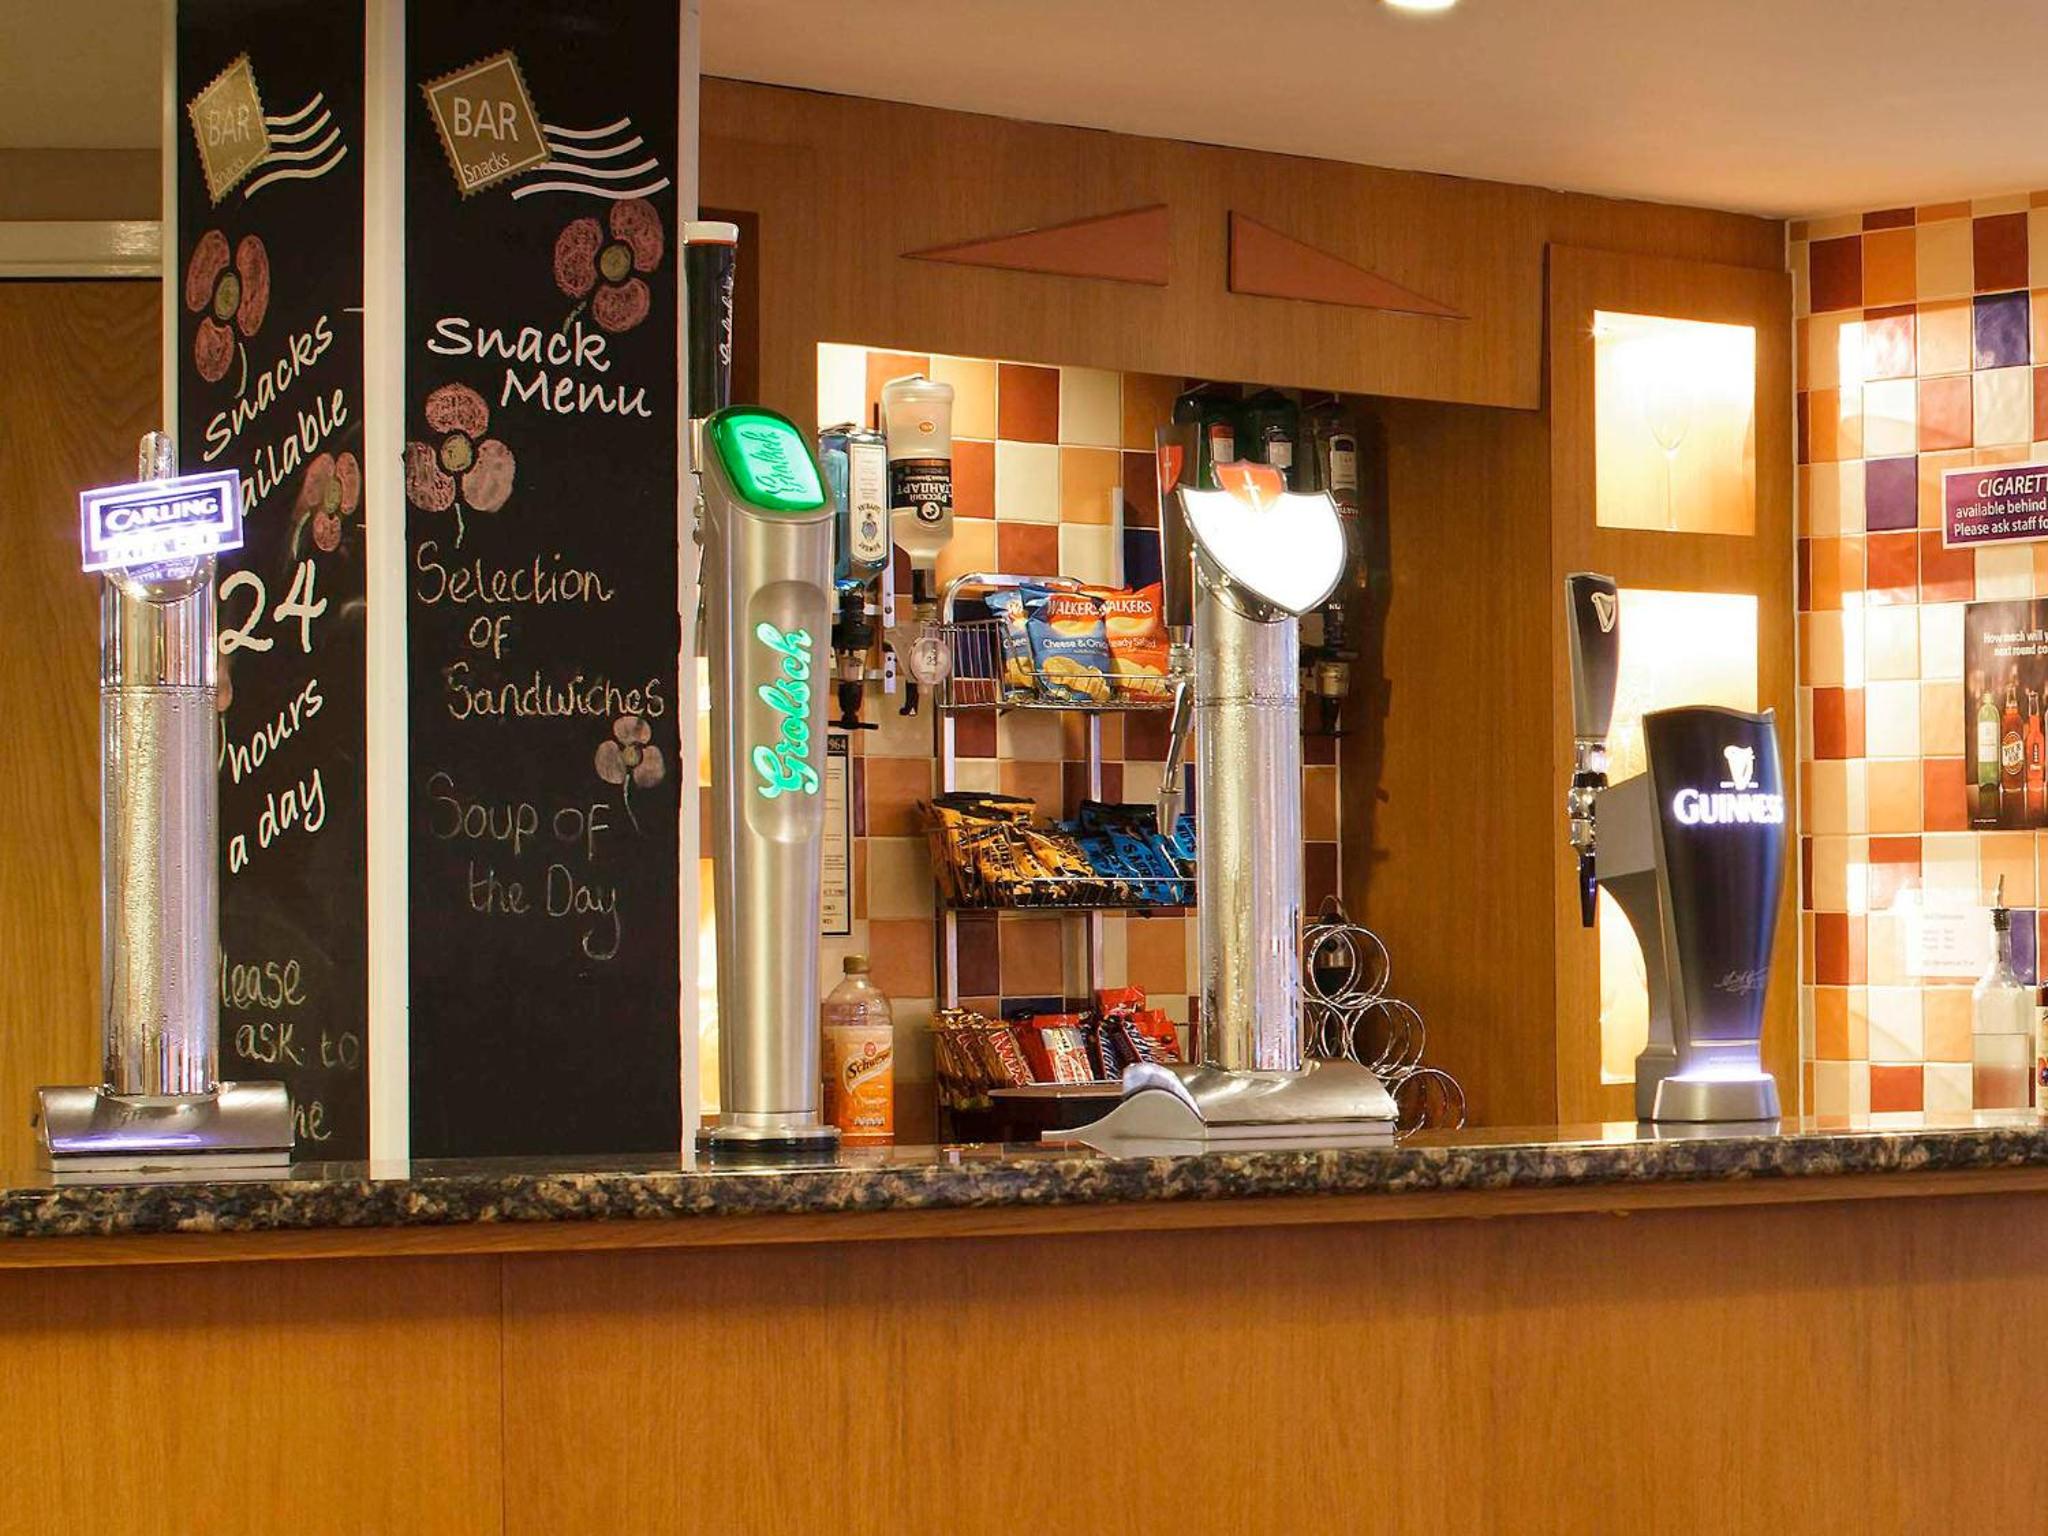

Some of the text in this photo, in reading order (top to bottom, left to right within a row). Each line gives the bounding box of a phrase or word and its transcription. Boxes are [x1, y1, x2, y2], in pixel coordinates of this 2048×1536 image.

[208, 104, 250, 146] BAR
[454, 97, 519, 141] BAR
[463, 152, 510, 182] Snacks
[427, 317, 611, 372] Snack
[500, 370, 653, 418] Menu
[240, 389, 348, 517] ailable
[105, 497, 219, 532] CARLING
[1954, 522, 1990, 537] Please
[1991, 518, 2011, 533] ask
[2012, 516, 2037, 532] staff
[1956, 497, 2047, 519] available behind
[417, 540, 615, 604] Selection
[219, 558, 327, 655] 24
[1043, 638, 1076, 649] Cheese
[447, 661, 665, 720] Sandwiches
[753, 622, 819, 799] Grolsch
[228, 679, 323, 784] hours
[229, 768, 326, 874] a day
[469, 860, 621, 961] the Day
[221, 951, 307, 1010] lease
[235, 1022, 360, 1071] ask to
